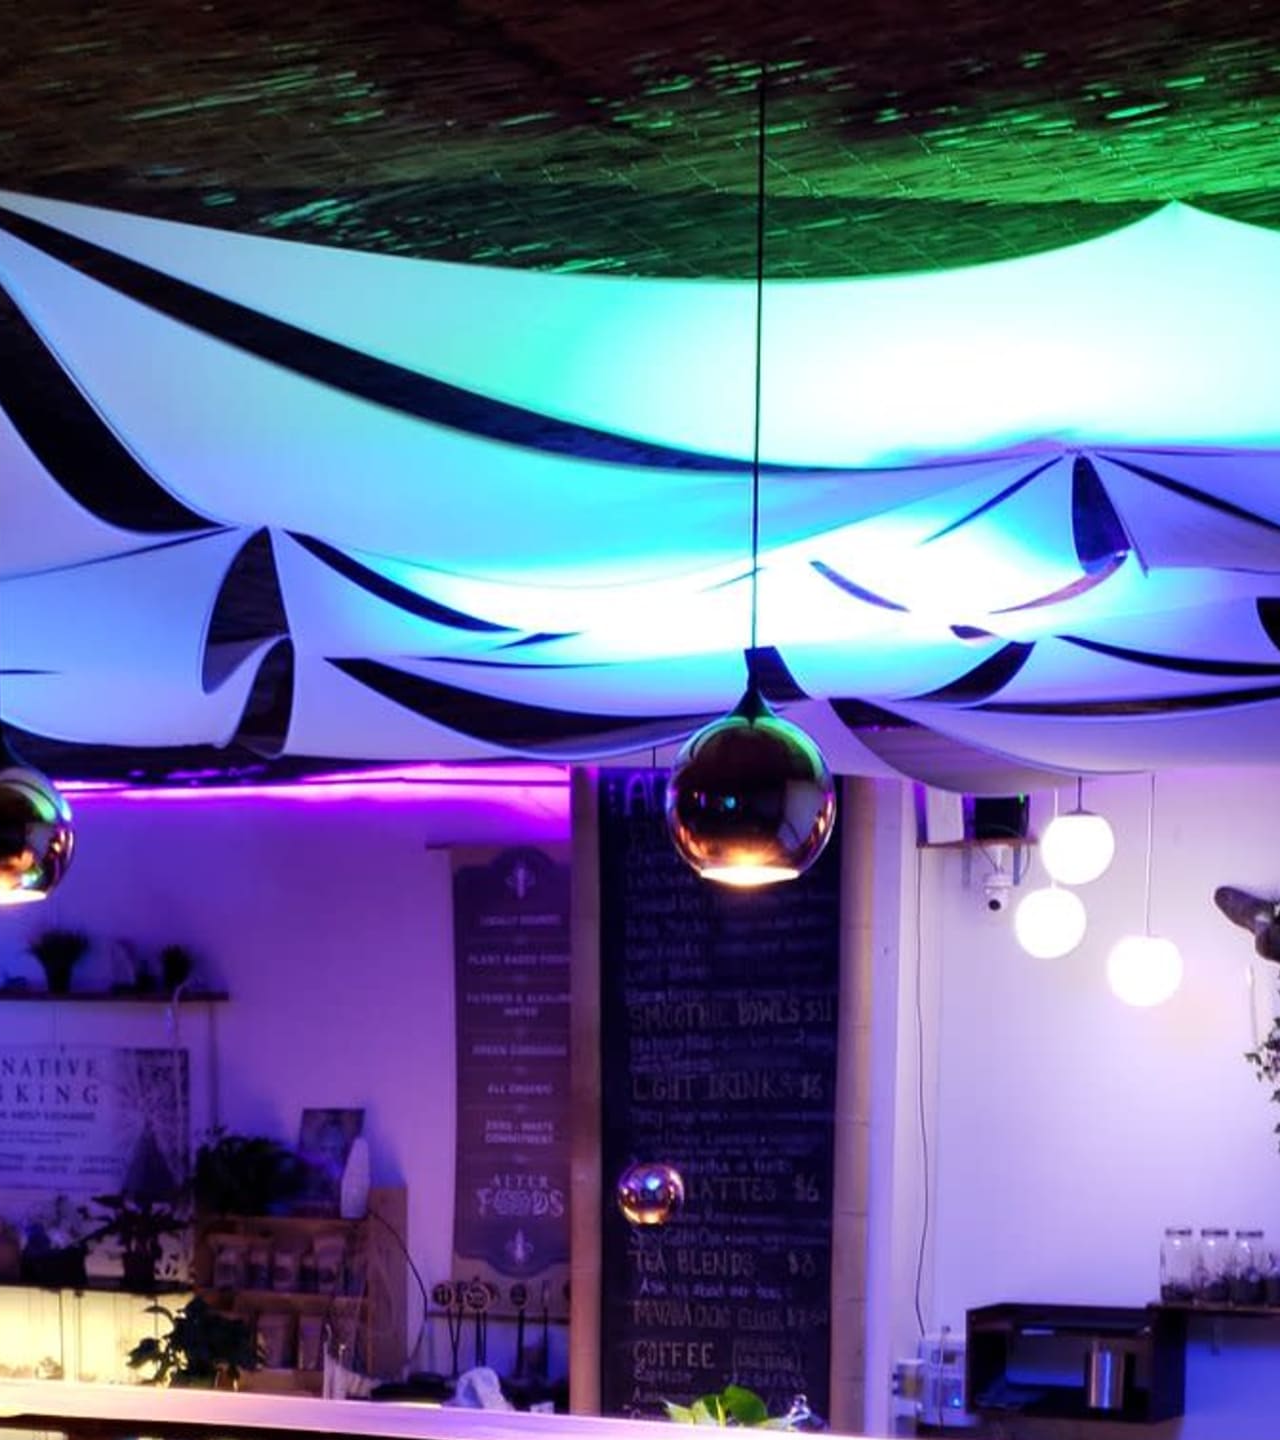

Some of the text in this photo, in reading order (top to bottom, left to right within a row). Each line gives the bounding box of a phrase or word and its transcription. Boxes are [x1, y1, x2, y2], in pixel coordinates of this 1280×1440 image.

[492, 1174, 549, 1189] ALTER
[688, 1176, 776, 1202] LATTES
[627, 1249, 668, 1273] TEA
[677, 1249, 756, 1277] BLENDS
[633, 1340, 716, 1370] COFFEE
